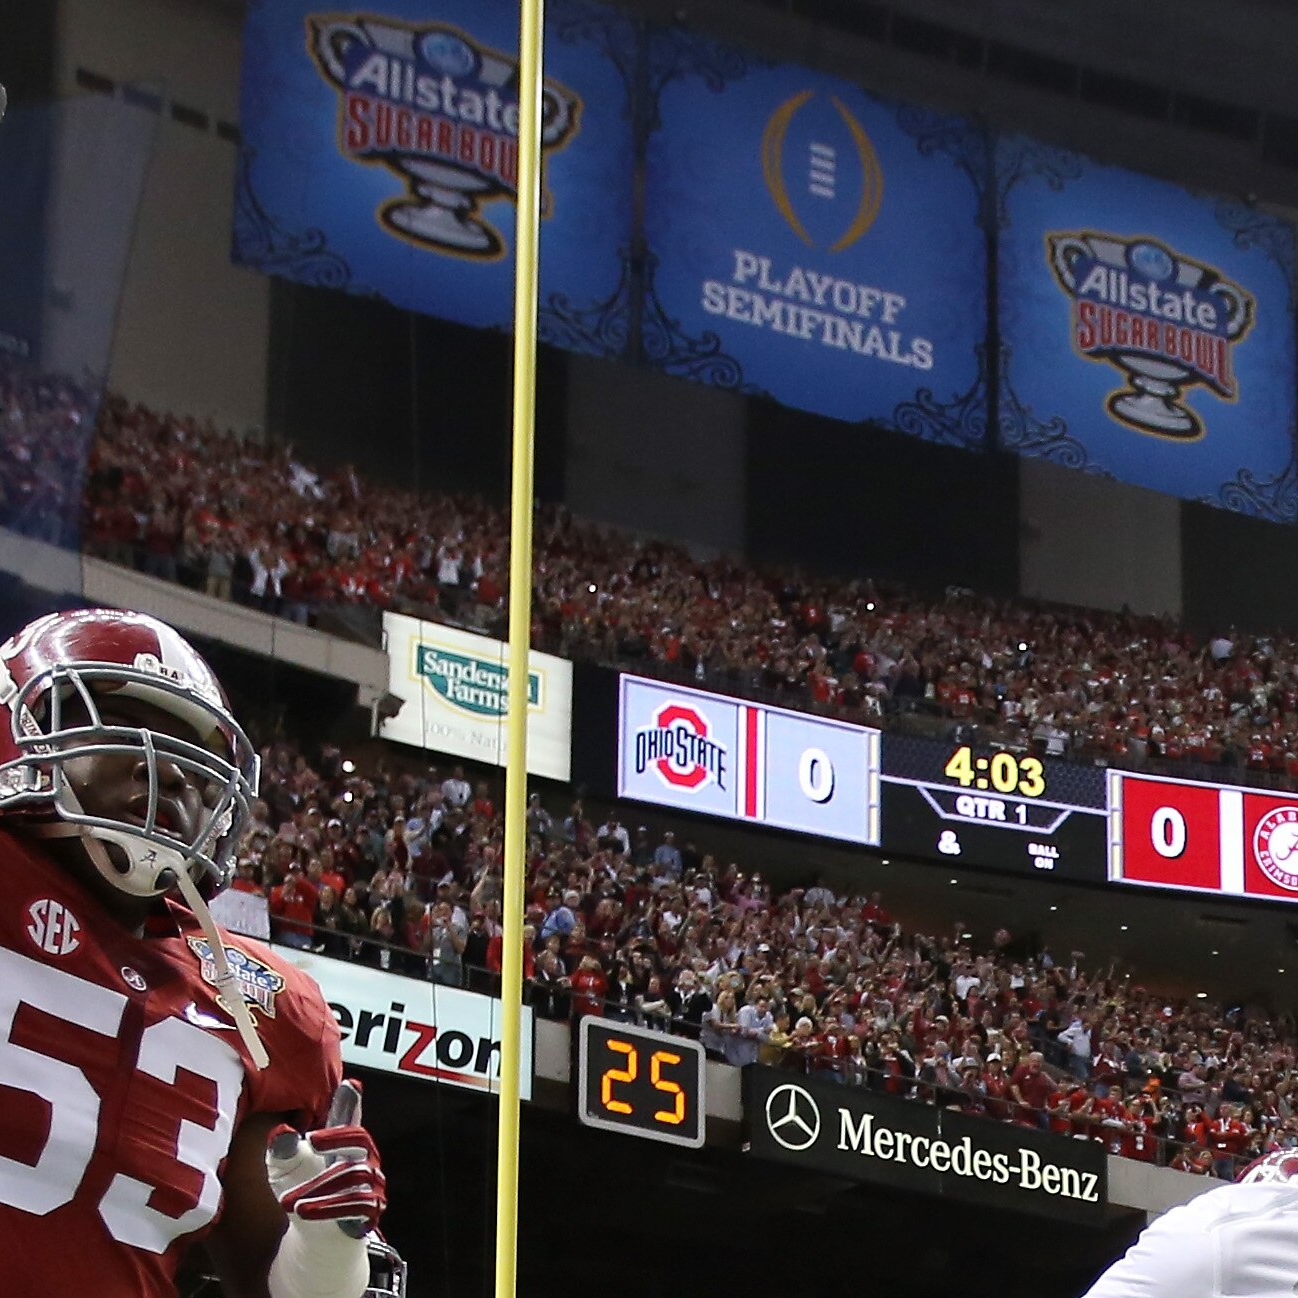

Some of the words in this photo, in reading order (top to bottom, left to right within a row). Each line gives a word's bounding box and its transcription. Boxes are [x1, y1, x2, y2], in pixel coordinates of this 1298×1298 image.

[352, 55, 518, 136] Allstate
[348, 97, 451, 154] SUGAR
[459, 126, 518, 185] BOW
[733, 250, 906, 324] PLAYOFF
[1079, 266, 1217, 330] Allstate
[703, 280, 934, 371] SEMIFINALS
[1080, 302, 1159, 351] SUGAR
[1165, 324, 1232, 391] BOWL
[446, 678, 509, 711] Farms
[636, 730, 673, 774] OHIO
[676, 727, 727, 791] STATE
[799, 748, 835, 804] 0
[945, 747, 1046, 797] 4:03
[956, 795, 1006, 820] QTR
[1015, 804, 1028, 825] 1
[1151, 806, 1187, 859] 0
[938, 830, 961, 855] &
[1028, 843, 1060, 859] BALL
[1034, 857, 1054, 869] ON
[27, 898, 81, 955] SEC
[328, 1001, 502, 1077] erizon
[601, 1039, 685, 1125] 25
[837, 1107, 1099, 1202] Mercedes-Benz
